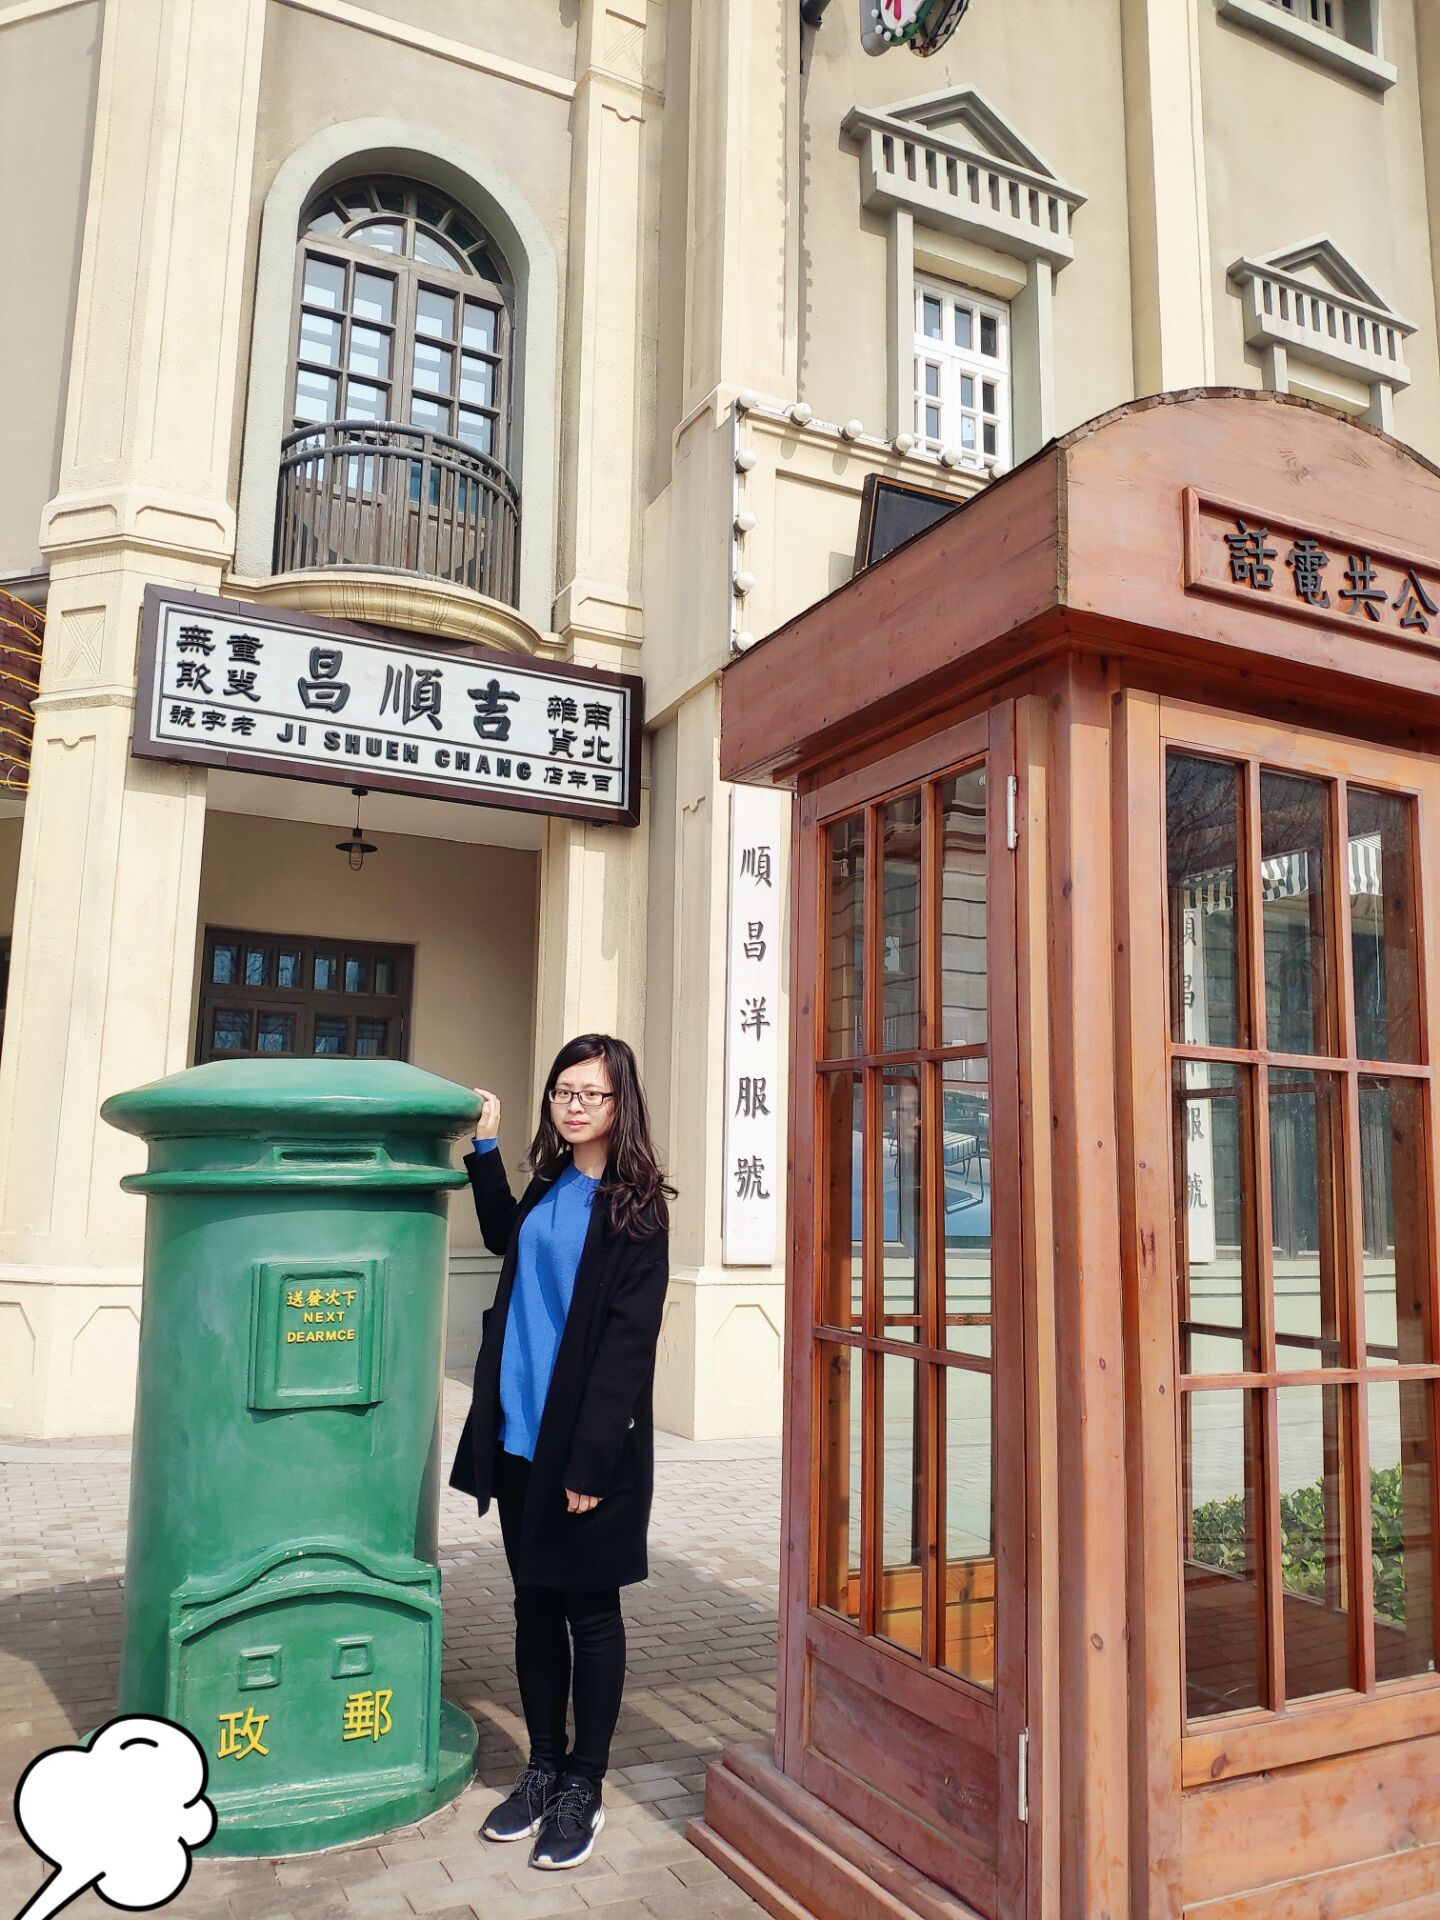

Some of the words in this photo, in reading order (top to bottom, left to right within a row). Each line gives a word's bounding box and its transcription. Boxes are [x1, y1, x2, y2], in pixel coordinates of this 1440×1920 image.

[276, 722, 307, 746] JI
[323, 729, 419, 764] SHUEN
[434, 748, 532, 781] CHANG
[734, 846, 773, 1202] 順昌洋服號
[303, 1311, 345, 1323] NEXT
[287, 1329, 355, 1343] DEARMCE
